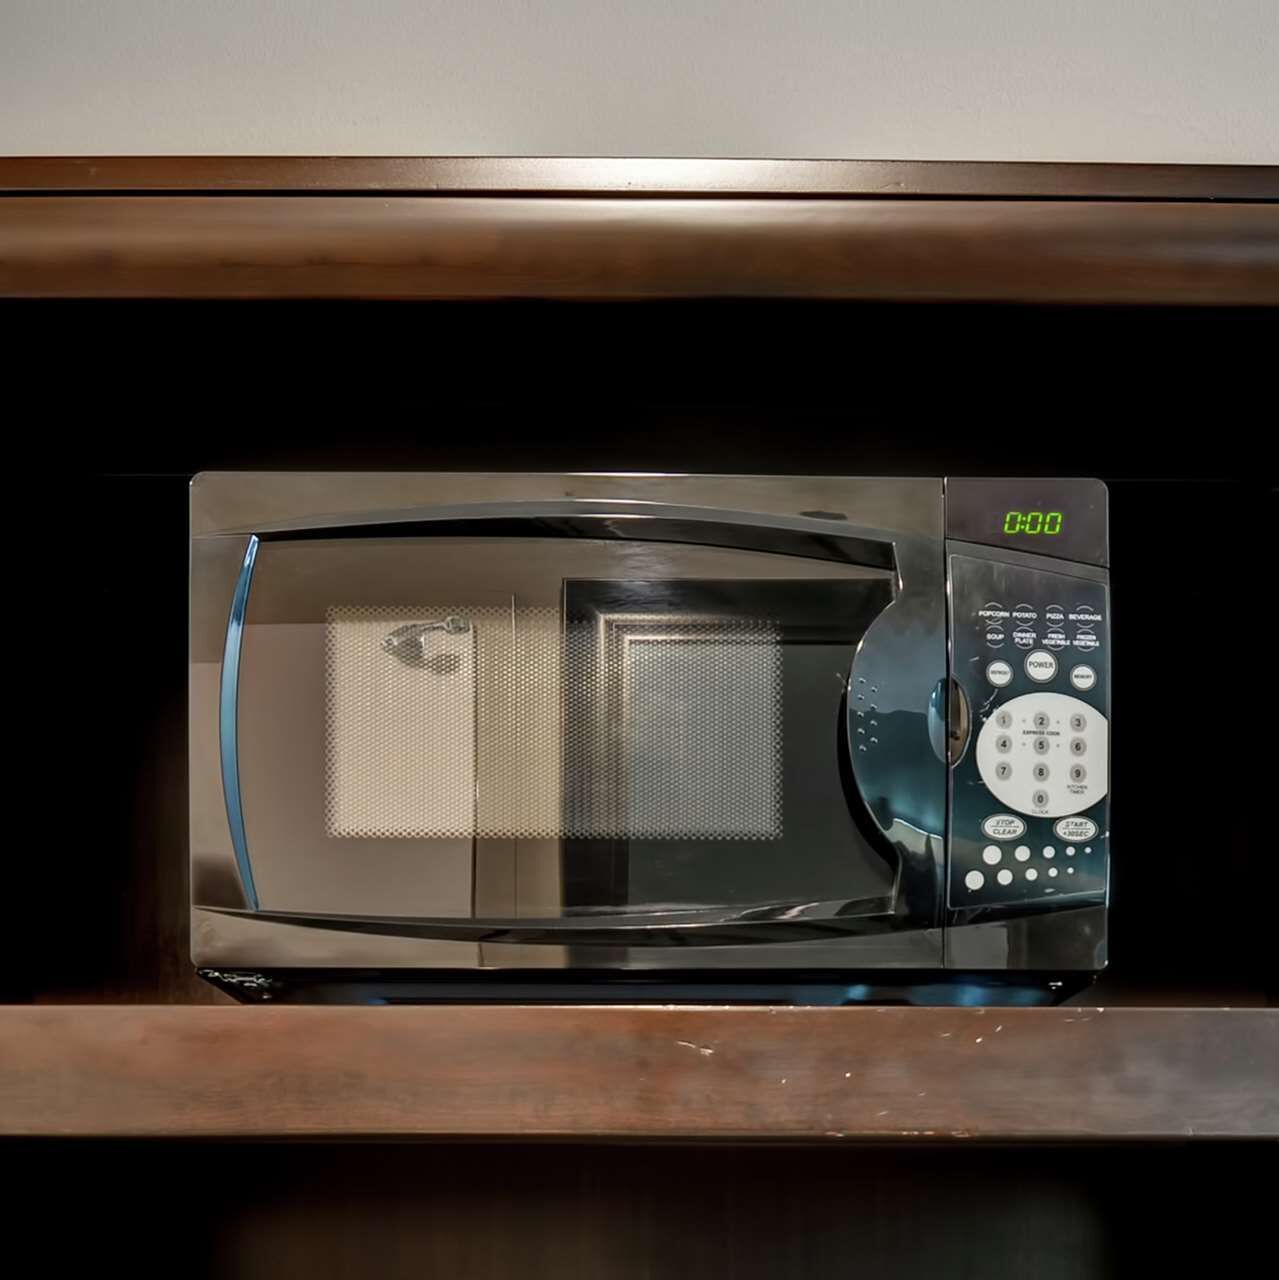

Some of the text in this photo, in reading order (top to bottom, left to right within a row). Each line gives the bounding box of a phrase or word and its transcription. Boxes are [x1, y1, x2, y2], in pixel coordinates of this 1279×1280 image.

[1004, 512, 1062, 534] 0:00
[978, 609, 1010, 618] POPCORN
[1012, 611, 1038, 619] POTATO
[1068, 613, 1103, 621] BEVERAGE
[986, 632, 1005, 640] SOUP
[1028, 660, 1054, 670] POWER
[992, 828, 1017, 836] CLEAR
